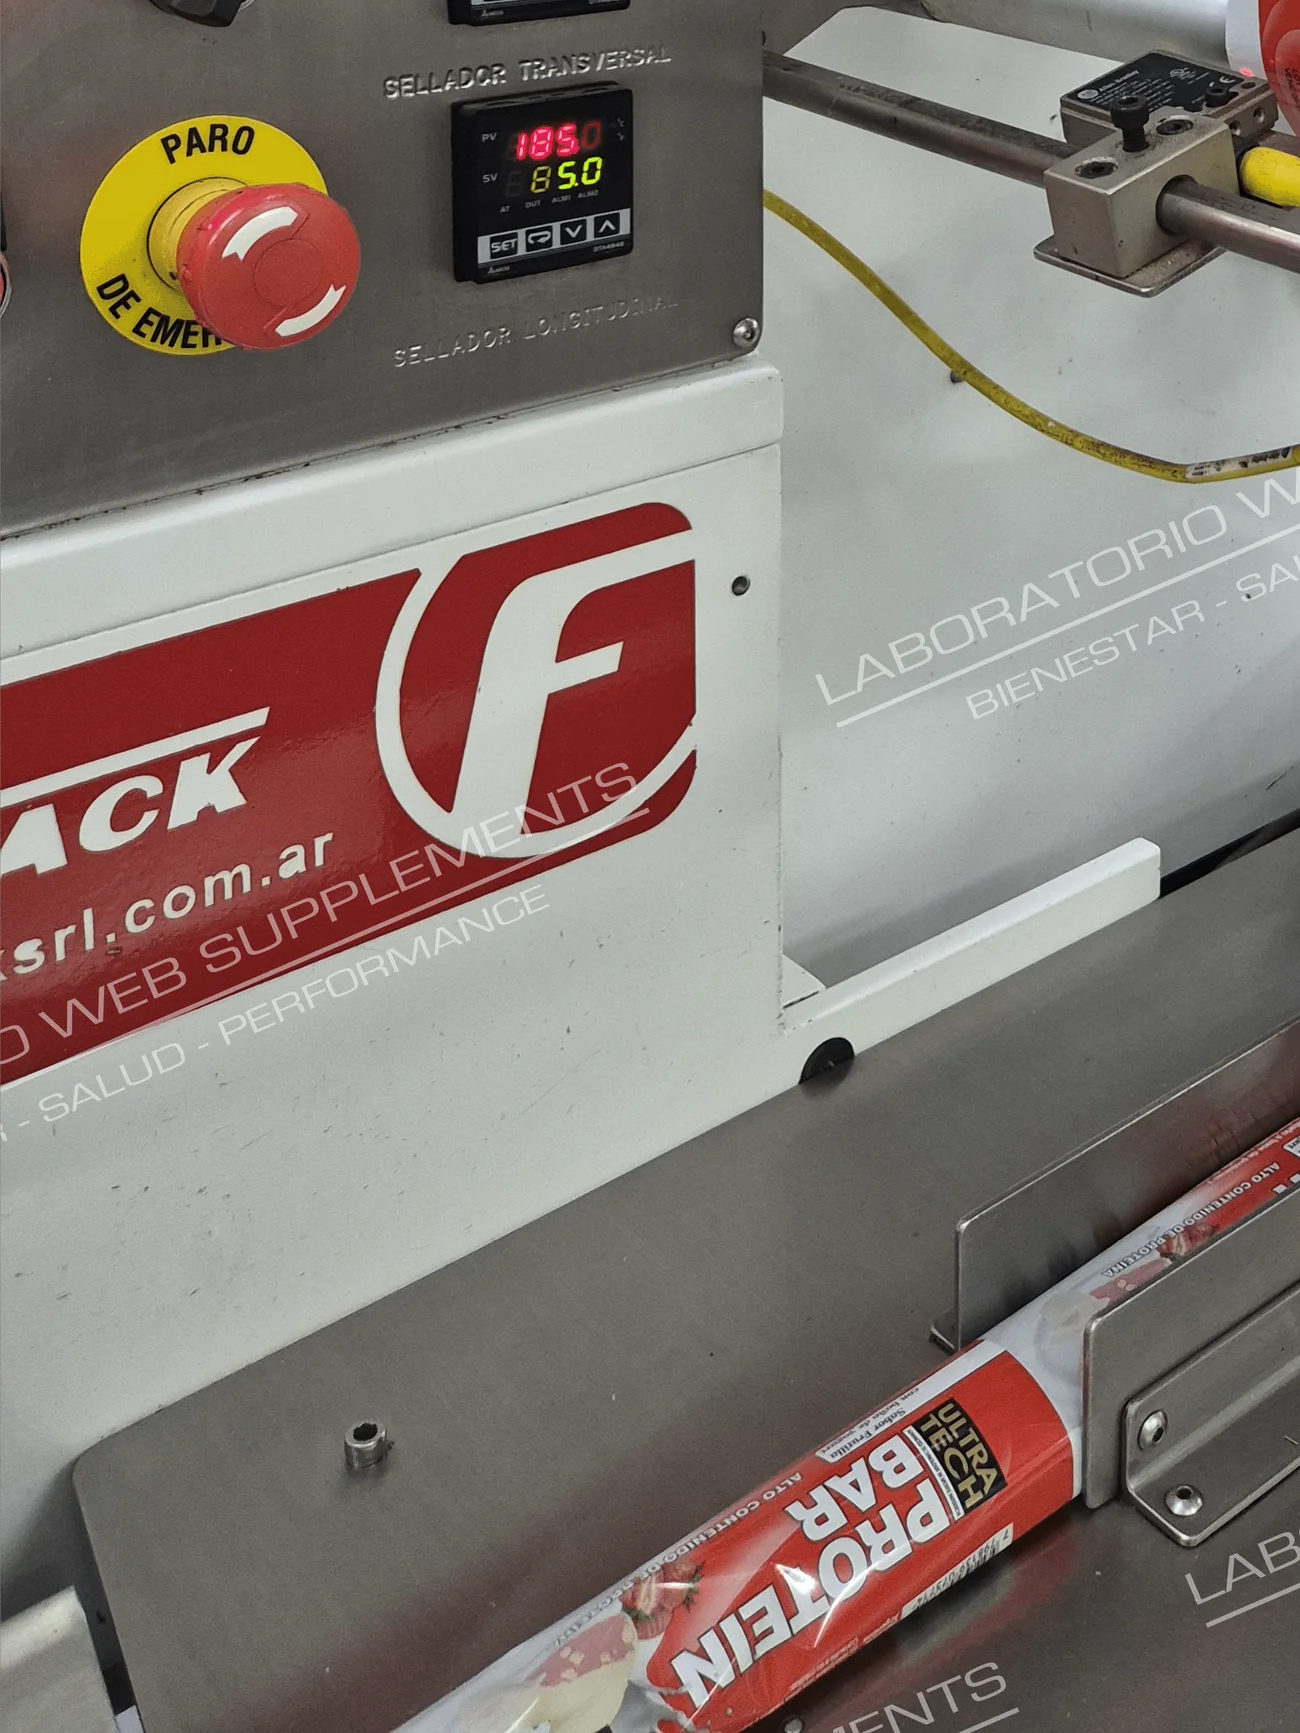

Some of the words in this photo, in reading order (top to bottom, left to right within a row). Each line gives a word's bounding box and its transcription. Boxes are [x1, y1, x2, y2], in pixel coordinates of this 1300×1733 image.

[382, 62, 508, 101] SELLADOR
[517, 43, 673, 83] TRANSVERSAL
[159, 122, 256, 165] PARO
[481, 132, 498, 143] PV
[482, 172, 499, 183] SV
[490, 238, 518, 253] SET
[96, 273, 142, 320] DE
[916, 1412, 986, 1509] TECH
[934, 1401, 997, 1495] ULTRA
[759, 1470, 803, 1501] ALTO
[782, 1433, 926, 1544] BAR
[661, 1498, 761, 1564] CONTENIDO
[666, 1475, 950, 1711] PROTEIN
